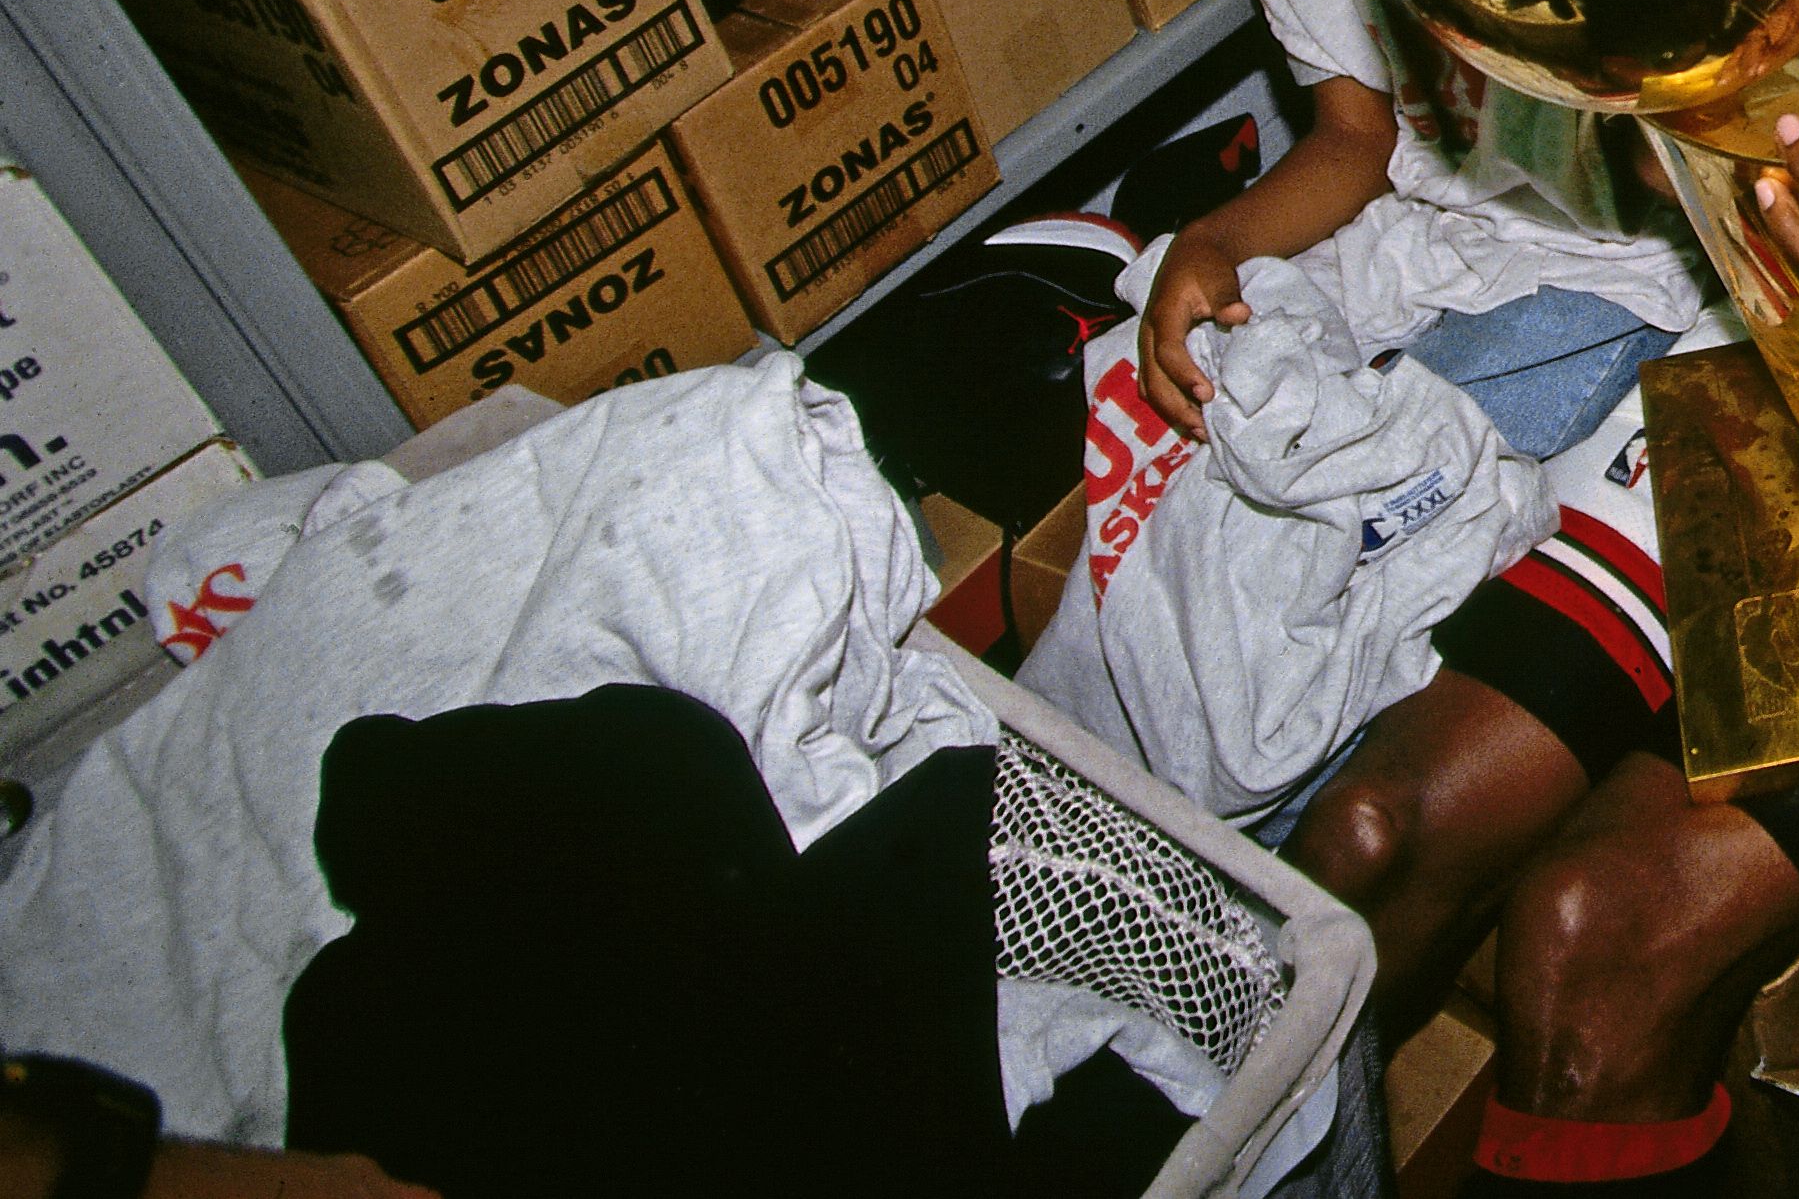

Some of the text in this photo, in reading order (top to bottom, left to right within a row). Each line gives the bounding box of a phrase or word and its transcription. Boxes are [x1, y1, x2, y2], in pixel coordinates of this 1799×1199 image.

[893, 40, 940, 92] 04
[42, 455, 86, 485] INC
[1393, 488, 1457, 527] XXXL
[23, 584, 78, 615] No.
